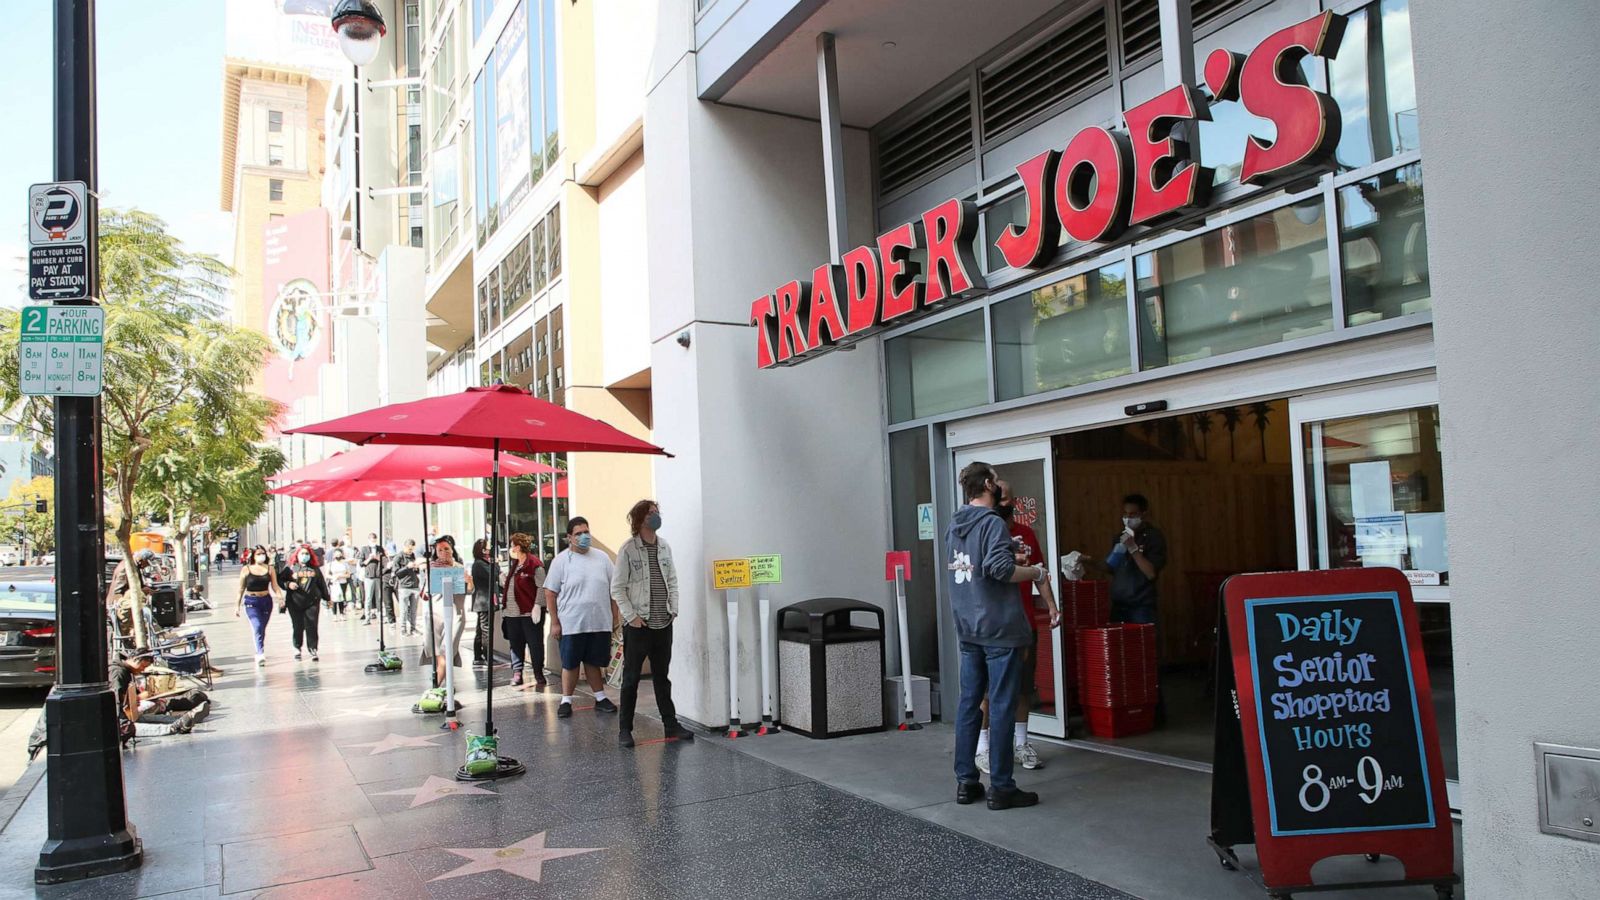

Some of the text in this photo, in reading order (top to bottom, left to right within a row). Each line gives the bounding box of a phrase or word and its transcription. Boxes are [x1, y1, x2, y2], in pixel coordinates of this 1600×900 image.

[291, 20, 339, 39] INSTA
[291, 32, 339, 49] INFLUEN
[751, 9, 1347, 370] TRADER JOE'S
[43, 264, 72, 275] PAY AT
[31, 275, 85, 288] PAY STATION
[27, 309, 88, 332] 2 HOUR
[49, 318, 99, 334] PARKING
[25, 347, 42, 359] 8AM
[51, 347, 69, 359] 8AM
[24, 370, 41, 381] 8PM
[77, 370, 96, 382] 8PM
[922, 506, 931, 523] A
[1275, 608, 1363, 646] Daily
[1272, 651, 1377, 688] Senior
[1270, 688, 1391, 721] Shopping
[1292, 722, 1373, 752] Hours
